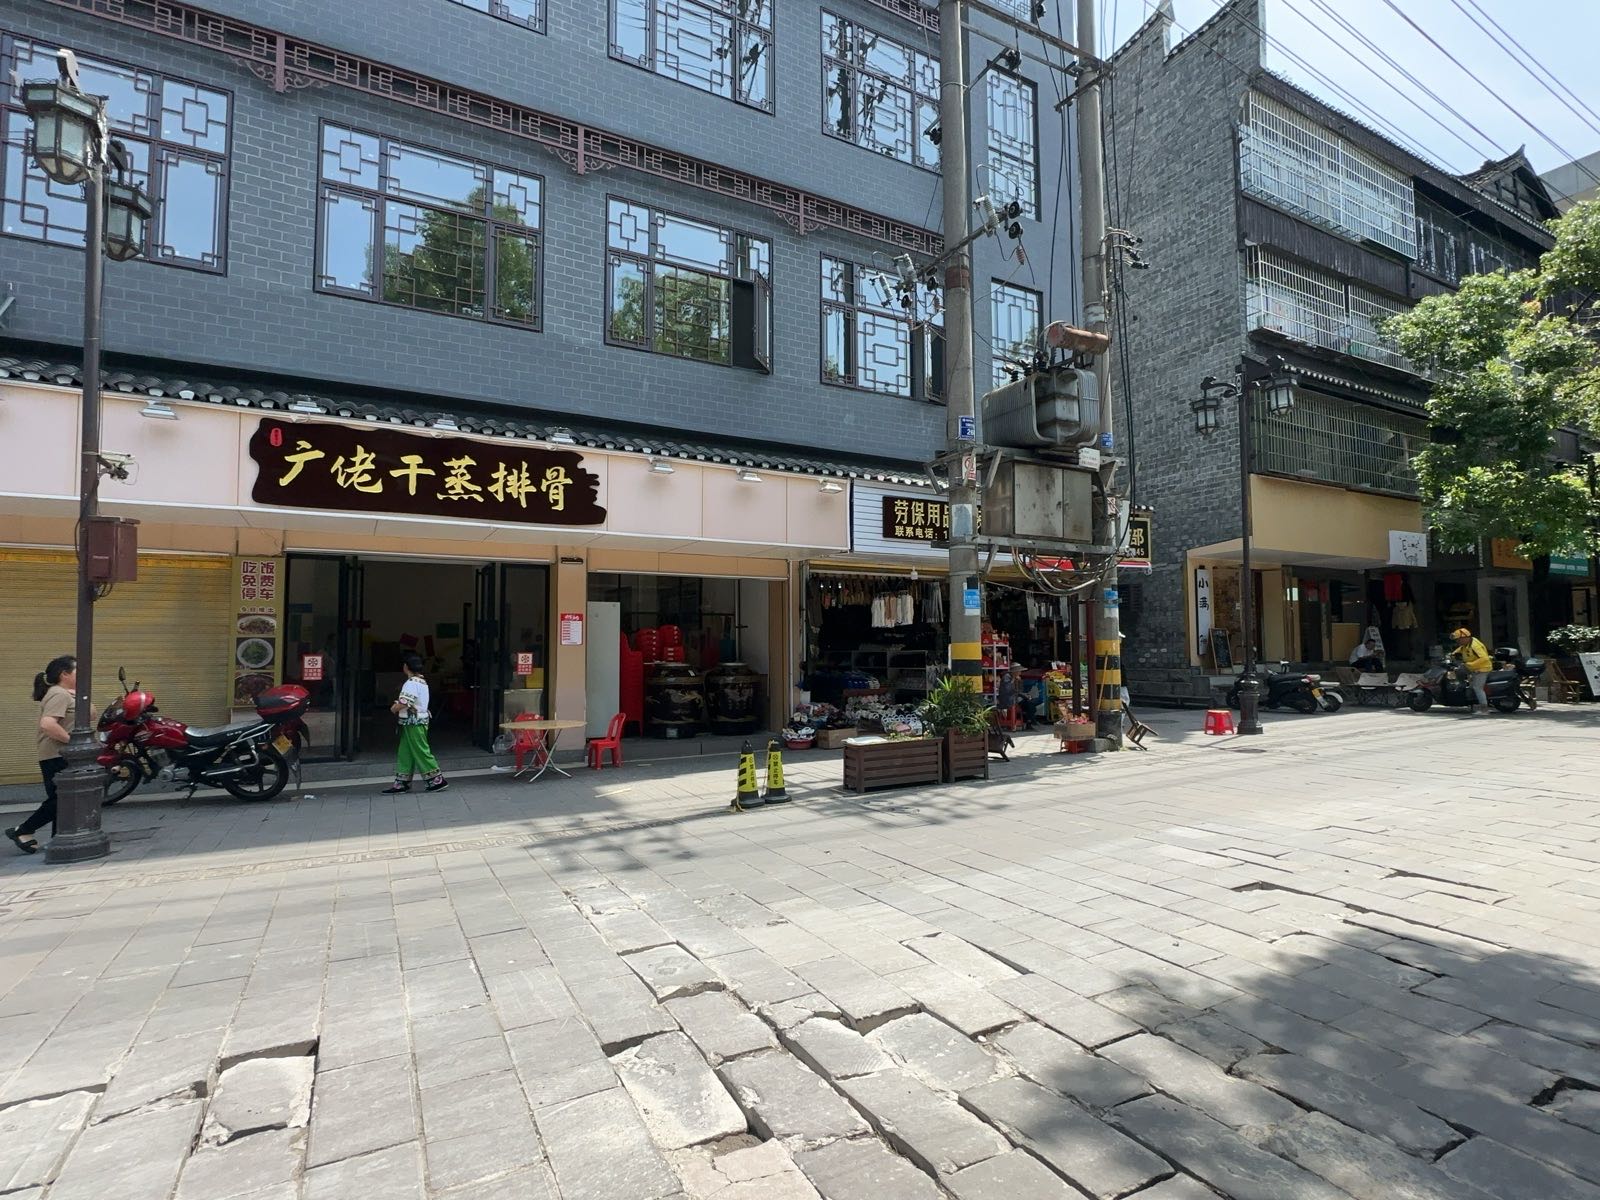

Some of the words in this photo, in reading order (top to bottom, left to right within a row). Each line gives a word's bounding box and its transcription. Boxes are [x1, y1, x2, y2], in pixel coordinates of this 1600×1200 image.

[279, 440, 574, 511] 广佬干蒸排骨
[242, 561, 275, 574] 吃饭
[241, 574, 275, 587] 免费
[241, 587, 275, 601] 停车
